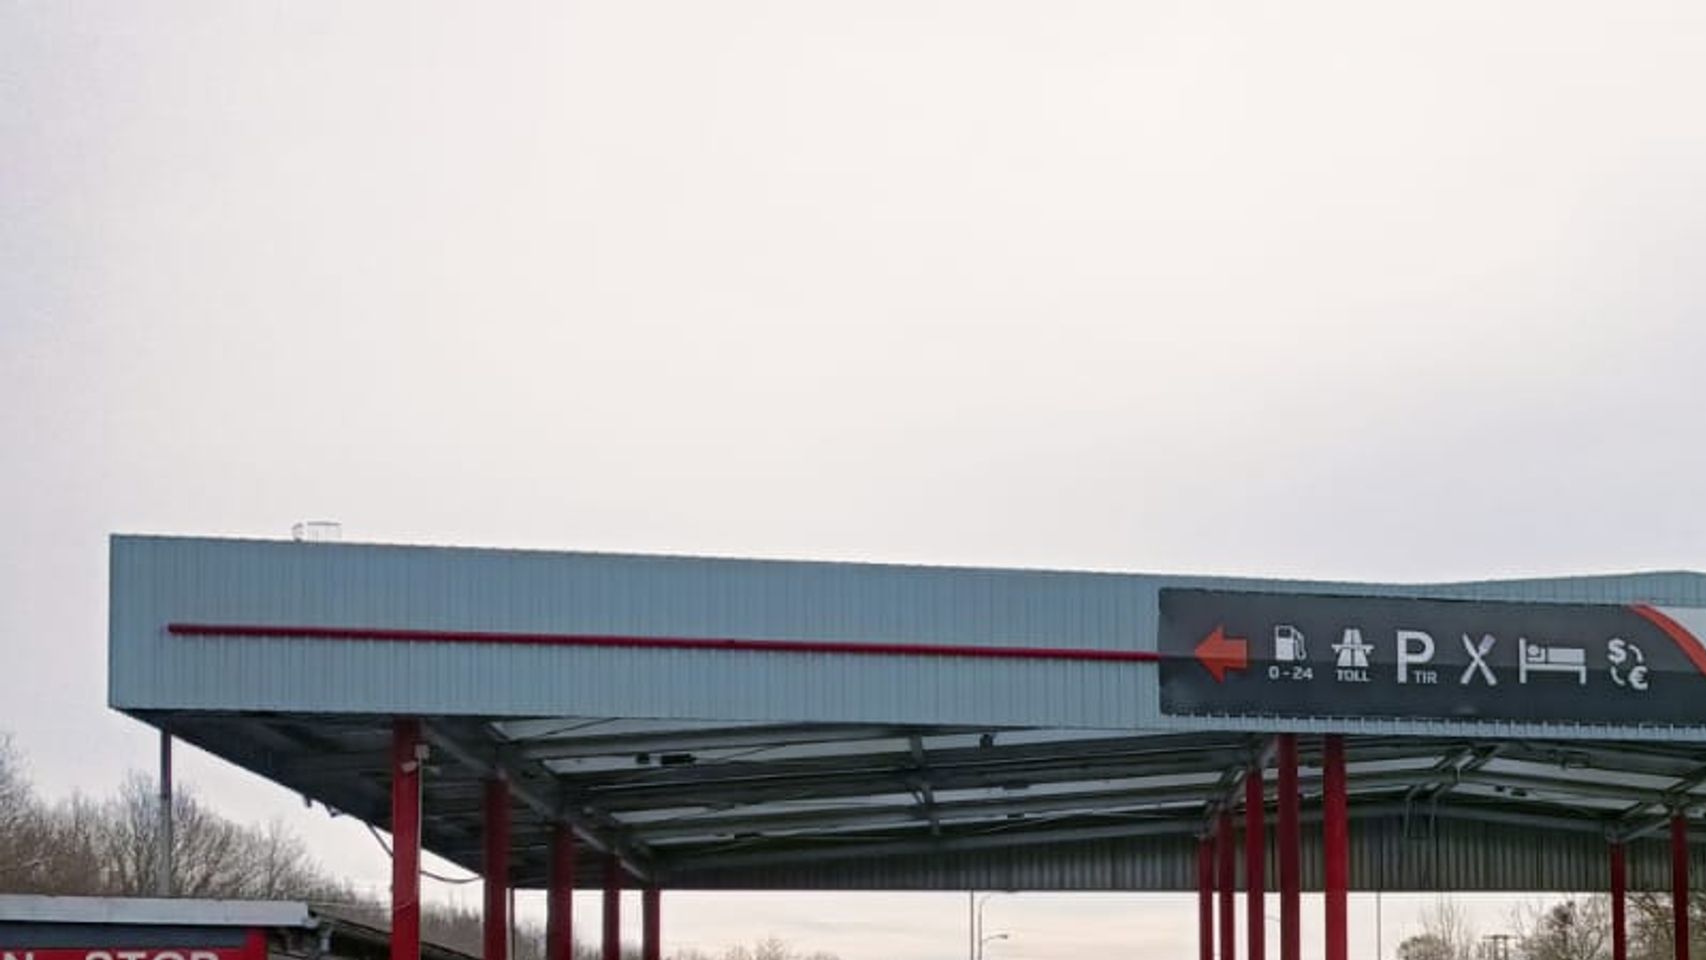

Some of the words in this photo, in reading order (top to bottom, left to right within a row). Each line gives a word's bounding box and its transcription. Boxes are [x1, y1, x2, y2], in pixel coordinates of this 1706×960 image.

[1397, 630, 1435, 683] P
[1336, 669, 1370, 682] TOLL
[1413, 670, 1437, 683] TIR
